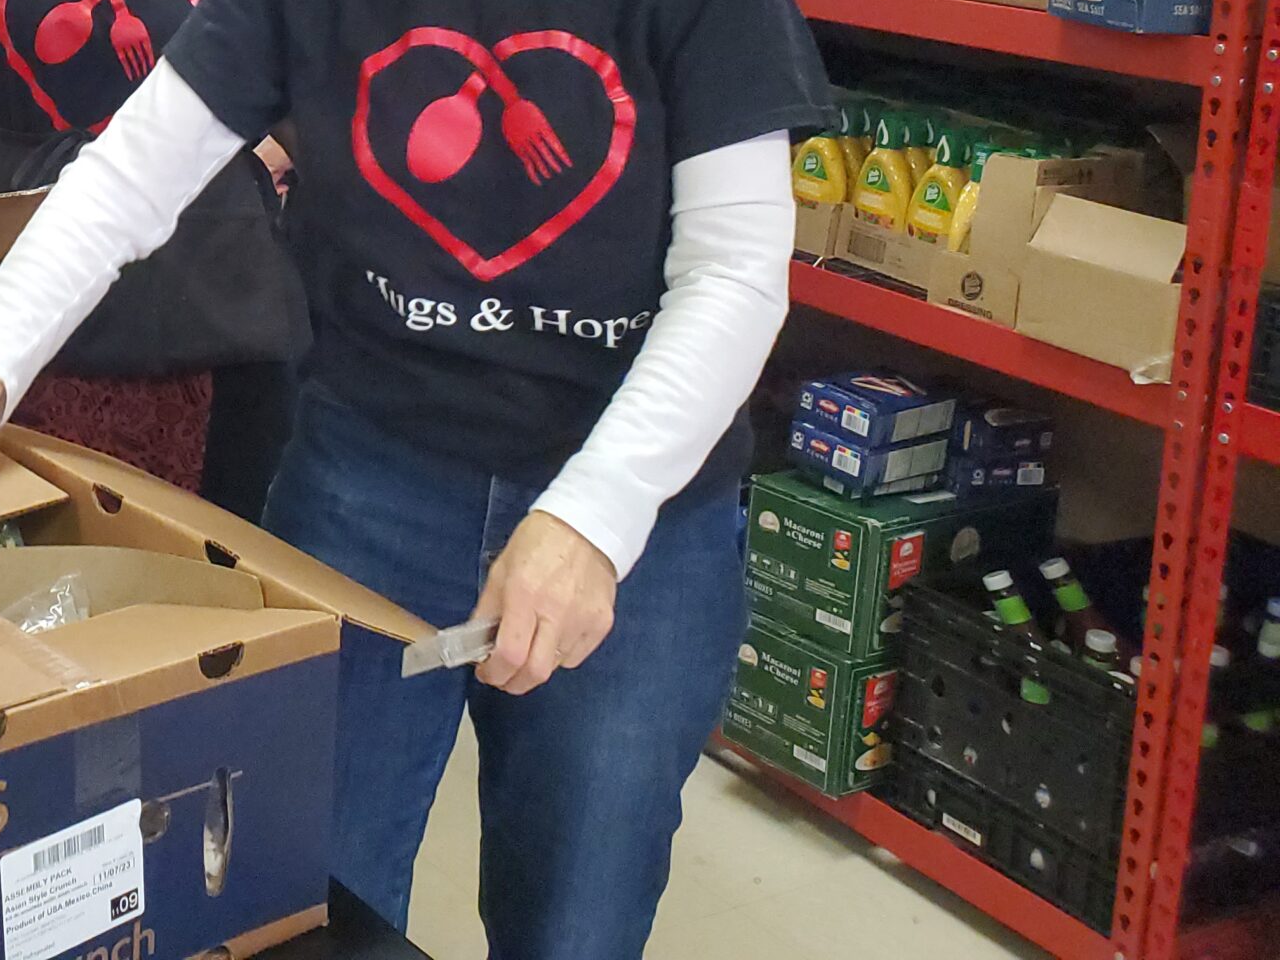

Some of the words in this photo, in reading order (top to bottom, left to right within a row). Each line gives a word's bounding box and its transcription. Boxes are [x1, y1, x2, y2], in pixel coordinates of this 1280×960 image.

[1077, 2, 1089, 13] SEA
[1089, 5, 1105, 16] SALT
[1174, 5, 1188, 16] SEA
[470, 297, 514, 332] &
[947, 298, 993, 320] DRESSING
[783, 517, 825, 541] Macaroni
[762, 652, 802, 677] Macaroni
[98, 861, 131, 882] 11/07/23
[4, 876, 49, 903] ASSEMBLY
[50, 867, 73, 882] PACK
[5, 899, 27, 915] Asian
[28, 890, 48, 905] Style
[49, 877, 77, 895] Crunch
[120, 891, 138, 913] 09
[6, 918, 37, 934] Product
[37, 912, 46, 921] of
[75, 919, 156, 960] nch
